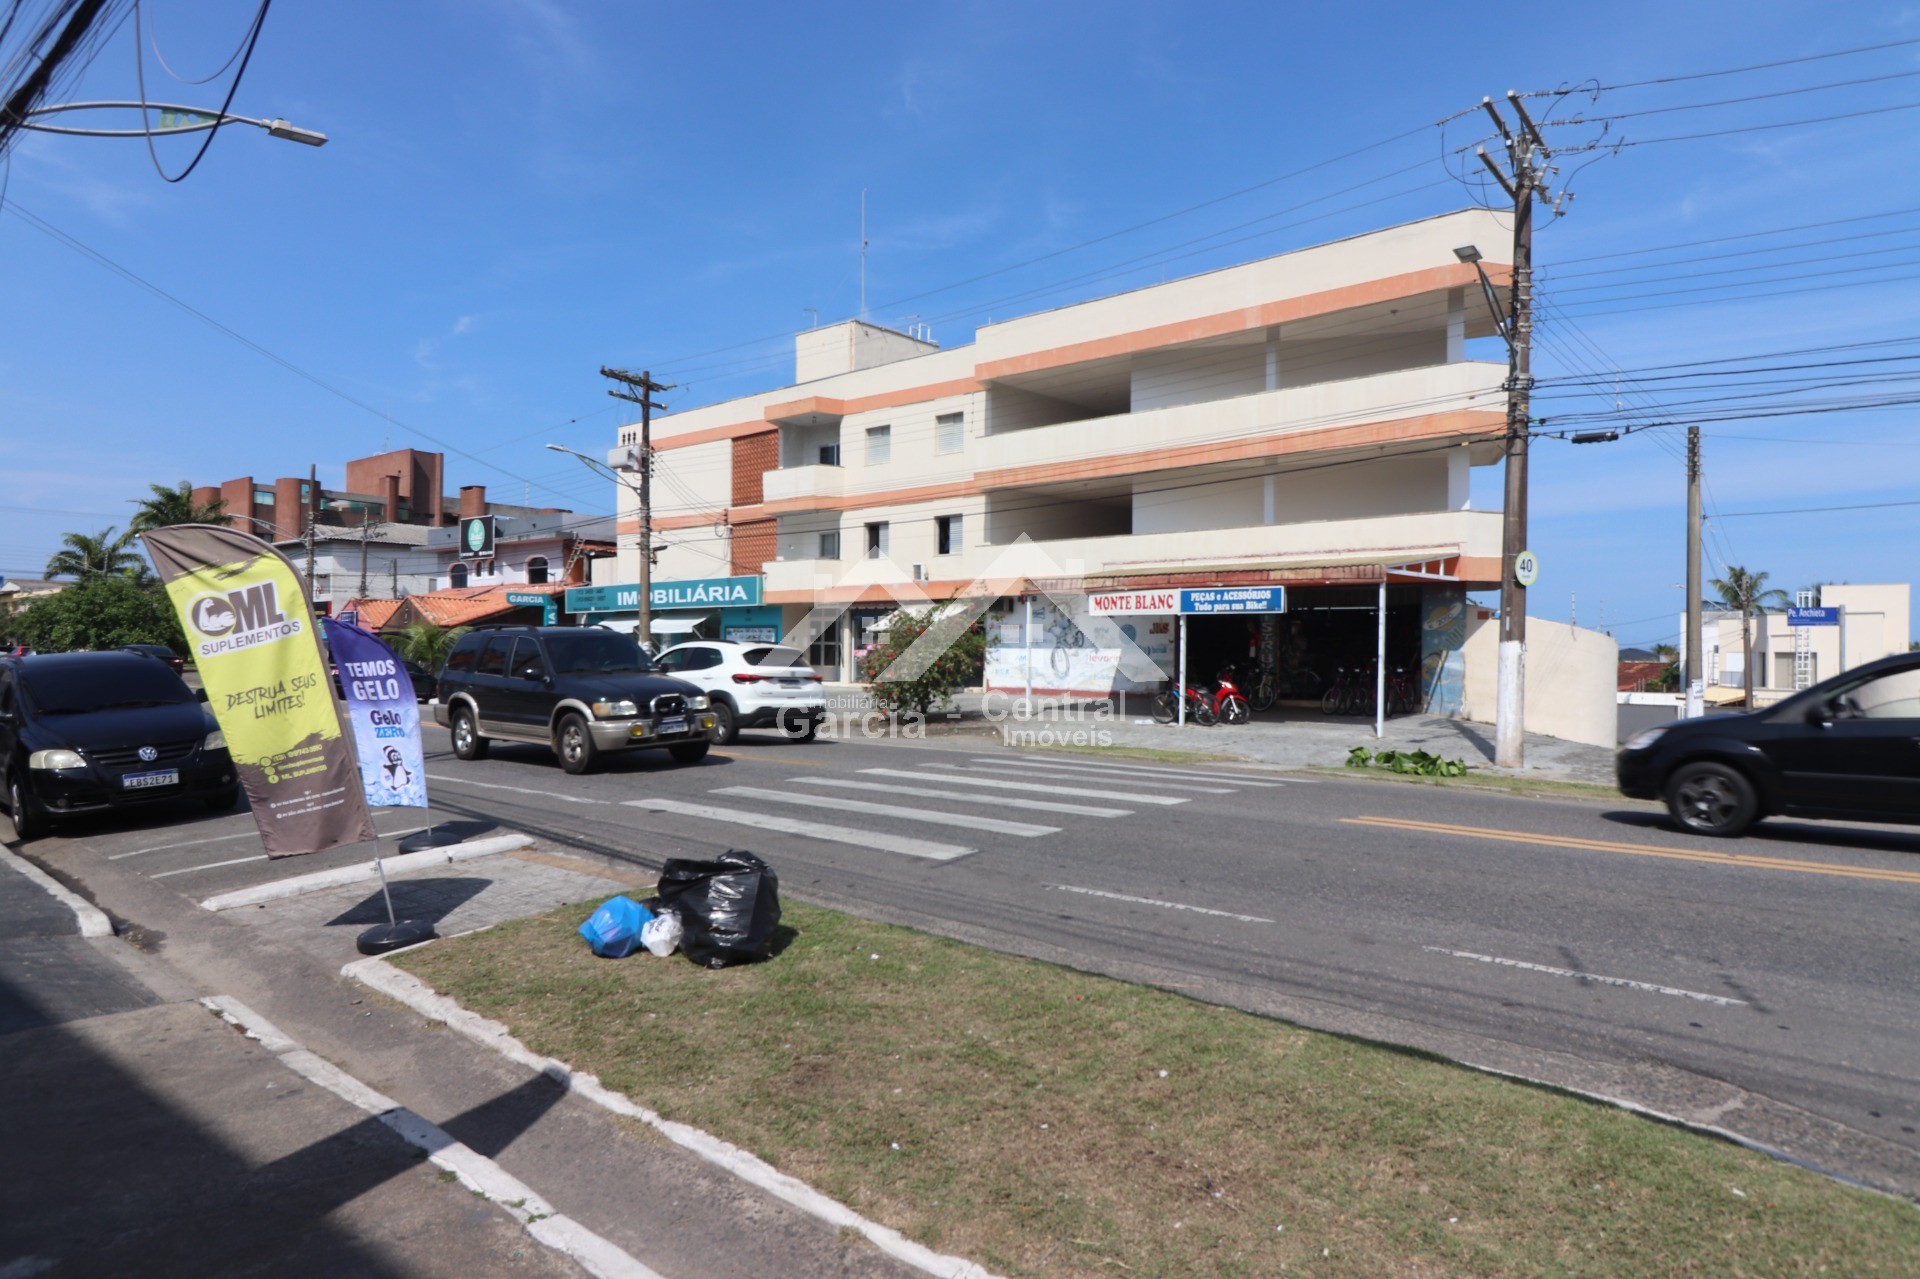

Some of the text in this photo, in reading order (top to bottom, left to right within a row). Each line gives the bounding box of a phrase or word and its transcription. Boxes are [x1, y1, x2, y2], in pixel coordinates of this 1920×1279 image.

[1520, 558, 1533, 573] 40
[509, 594, 544, 604] GARCIA
[1094, 593, 1174, 611] MONTE BLANC
[1190, 592, 1215, 603] PEÇAS
[1222, 588, 1272, 601] ACESSÓRIOS
[228, 582, 285, 635] ML
[1194, 602, 1213, 611] Tudo
[1213, 603, 1231, 612] para
[201, 621, 301, 655] SUPLEMENTOS
[345, 659, 396, 678] TEMOS
[225, 673, 317, 711] DESTRUA SEUS
[352, 678, 400, 701] GELO
[254, 691, 305, 719] LIMITES!
[370, 710, 402, 726] Gelo
[130, 774, 174, 788] EBS2E71
